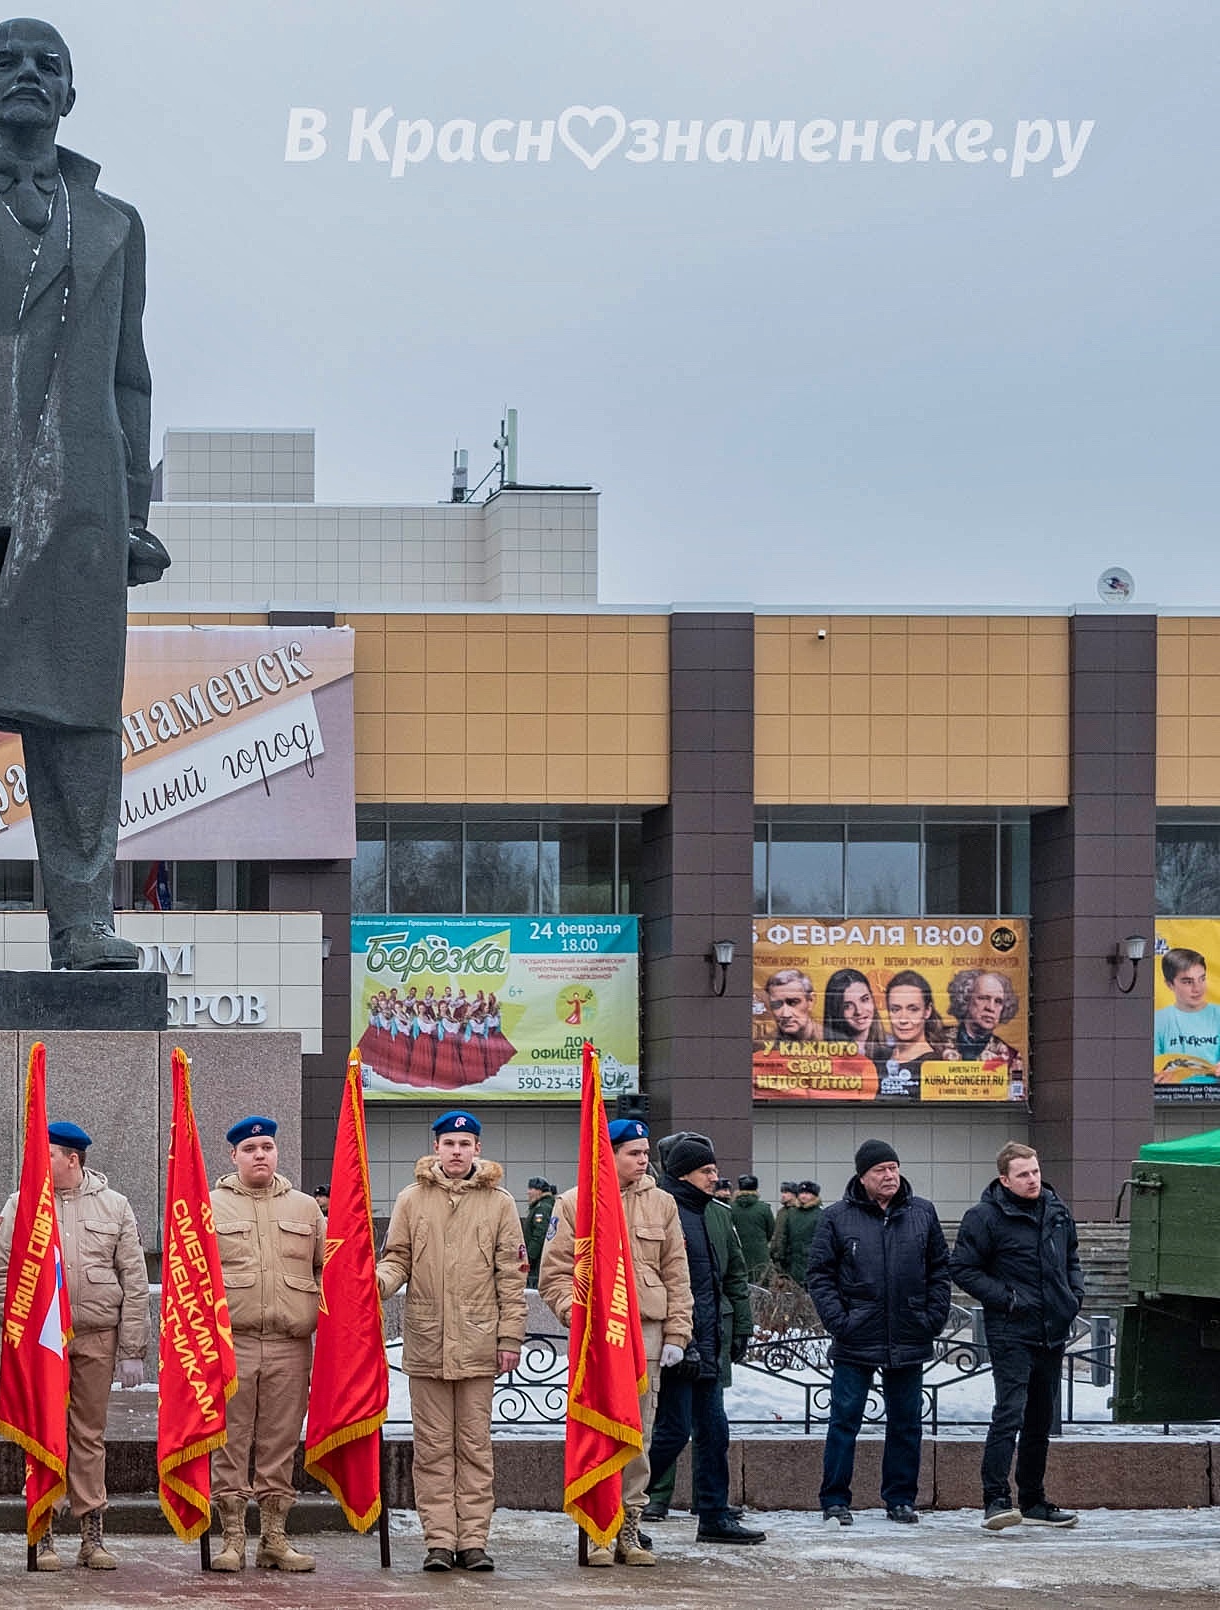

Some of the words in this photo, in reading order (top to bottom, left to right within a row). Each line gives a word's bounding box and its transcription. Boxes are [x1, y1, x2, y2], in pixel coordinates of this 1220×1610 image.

[221, 720, 315, 797] город
[530, 922, 553, 940] 24
[557, 922, 621, 937] февраля
[767, 925, 905, 946] ФЕВРАЛЯ
[913, 926, 984, 946] 18:00
[561, 938, 598, 952] 18.00
[366, 932, 506, 982] Берёзка
[508, 985, 524, 998] 6+
[167, 993, 269, 1027] ЕРОВ
[532, 1048, 602, 1060] ОФИЦЕРВ
[763, 1041, 775, 1056] У
[780, 1040, 858, 1057] КАЖДОГО
[532, 1066, 565, 1076] Ленина
[518, 1077, 581, 1089] 590-23-45
[756, 1075, 863, 1090] НЕДОСТАТКИ
[173, 1199, 215, 1306] СМЕРТЬ
[10, 1259, 41, 1320] НАШУ
[169, 1226, 220, 1364] МЕЦКИМ
[605, 1319, 627, 1349] ЗА
[166, 1296, 219, 1422] АТЧИКАМ
